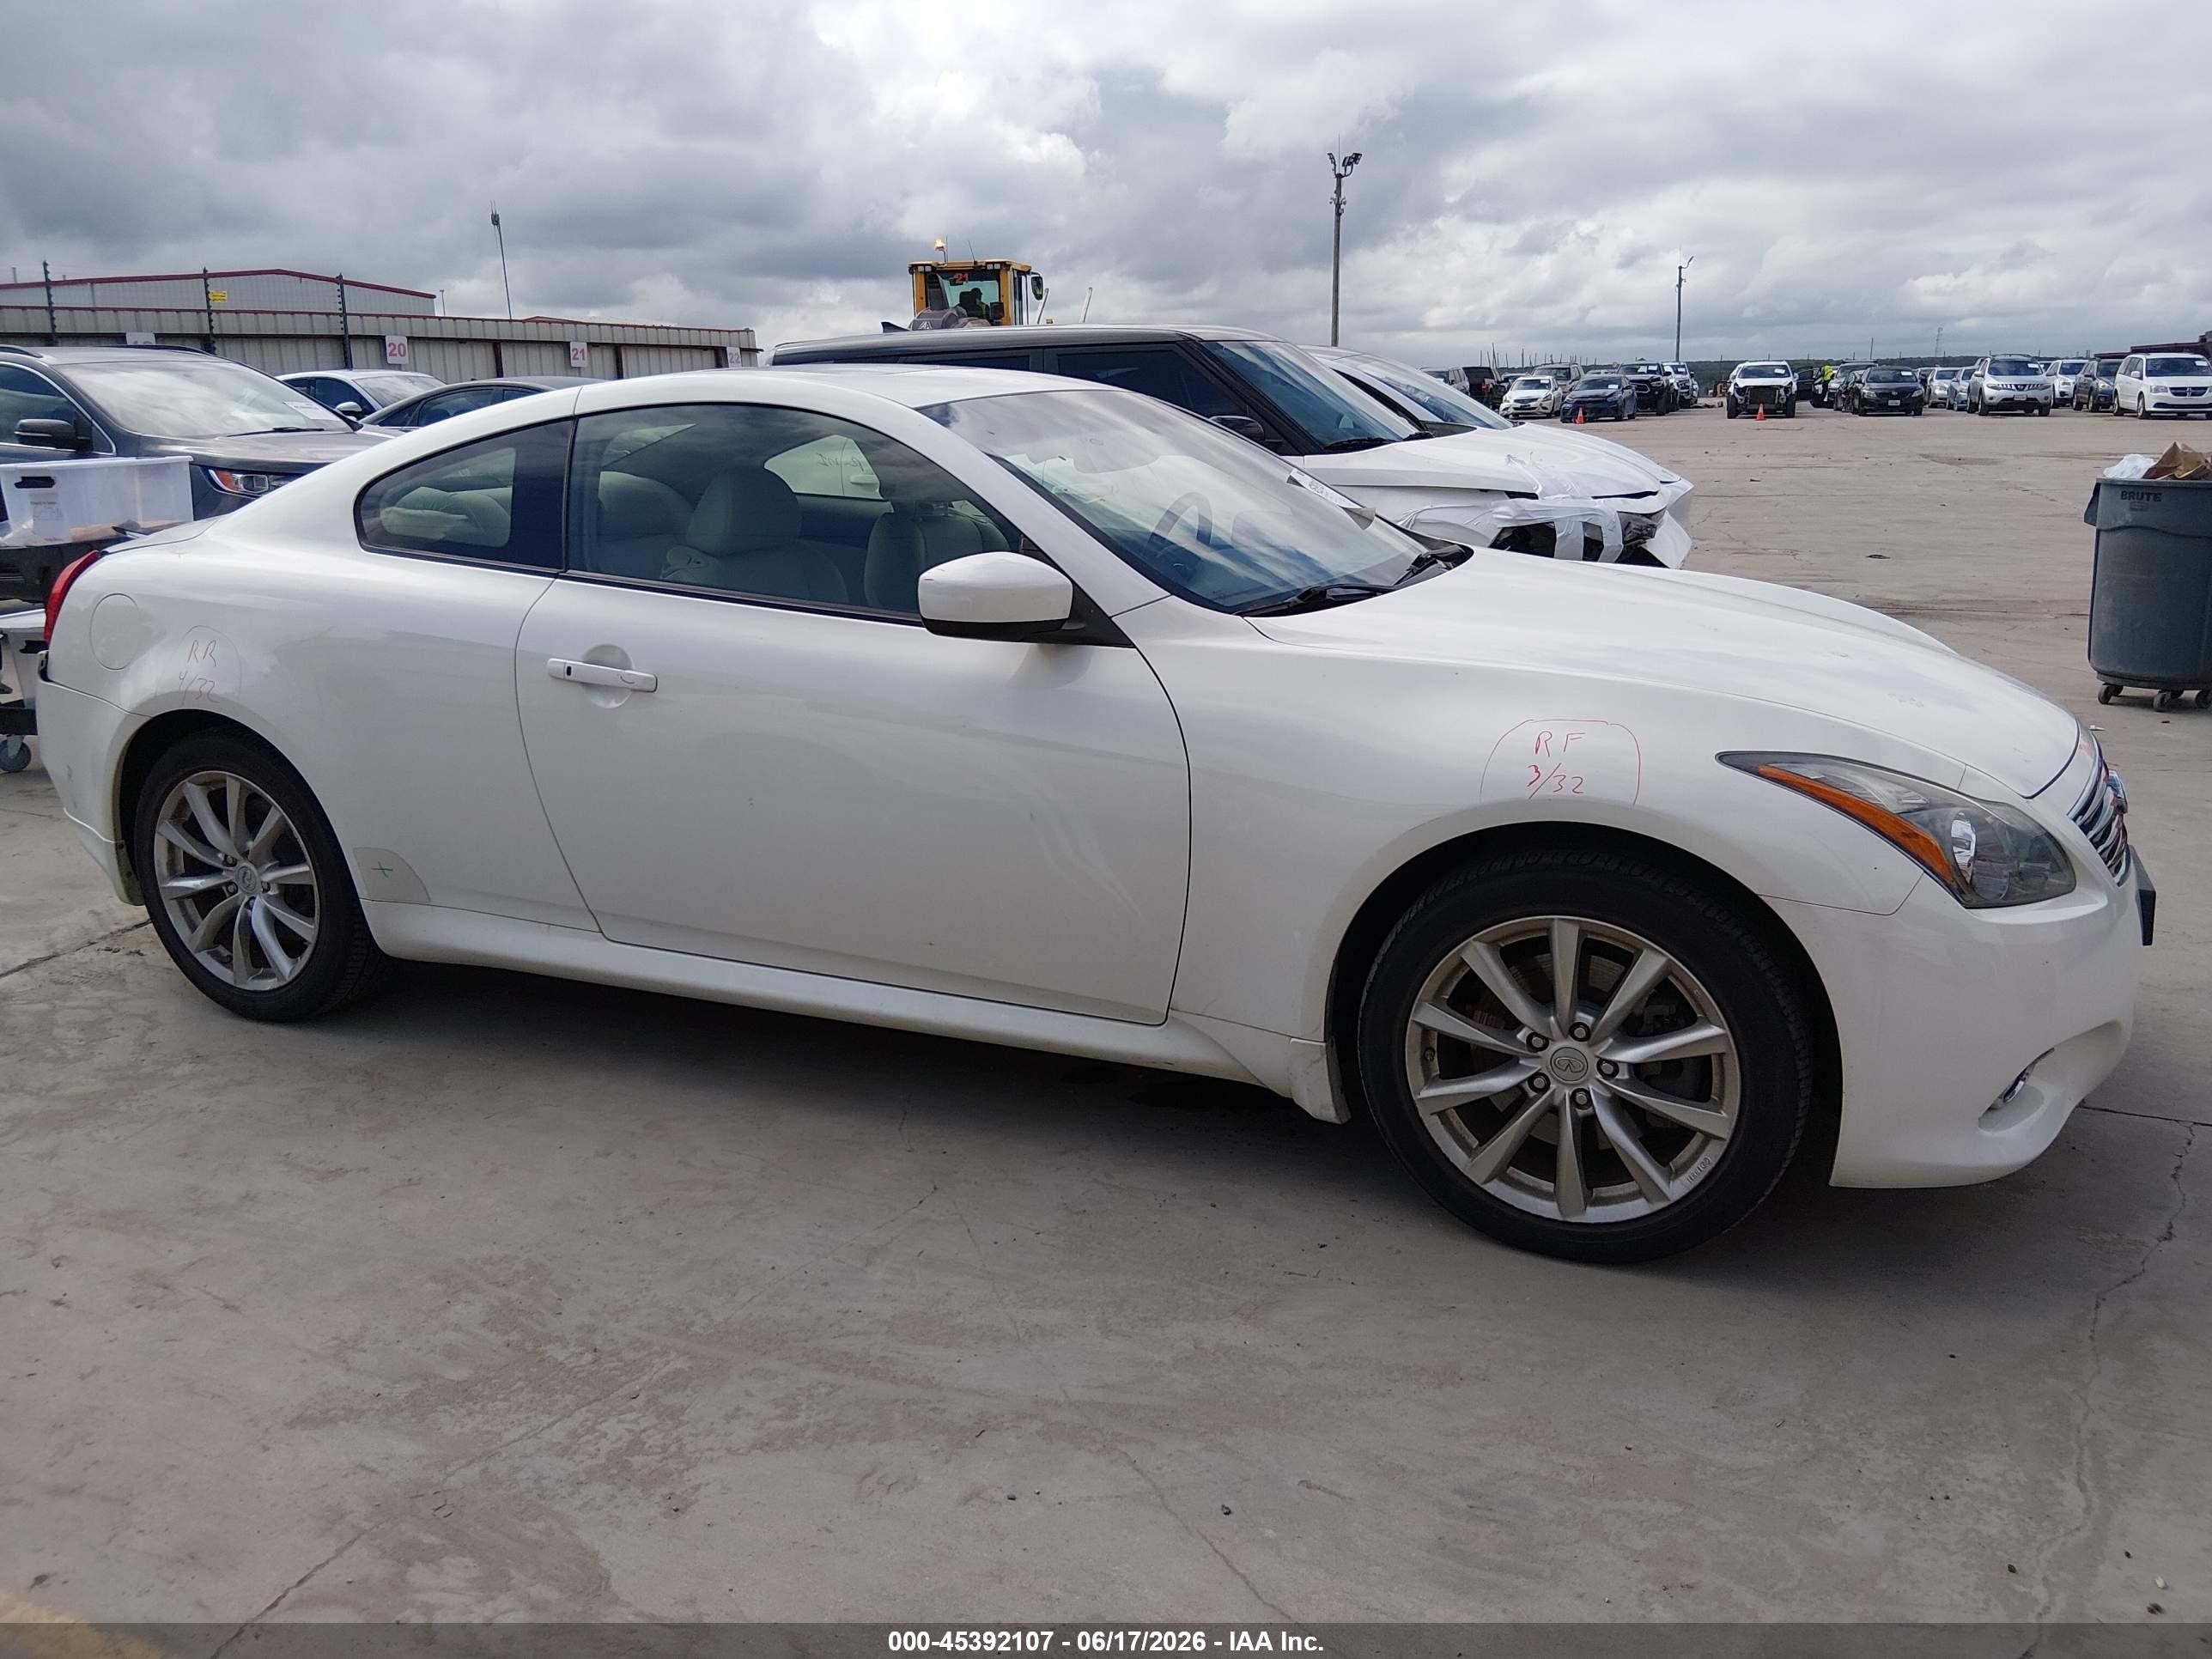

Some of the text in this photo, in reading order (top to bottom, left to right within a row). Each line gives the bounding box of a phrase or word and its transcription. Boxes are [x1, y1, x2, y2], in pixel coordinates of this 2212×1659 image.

[388, 342, 407, 358] 20
[571, 347, 586, 361] 21
[728, 352, 741, 364] 22
[2120, 490, 2162, 502] BRUTE
[1527, 763, 1584, 799] 3/32
